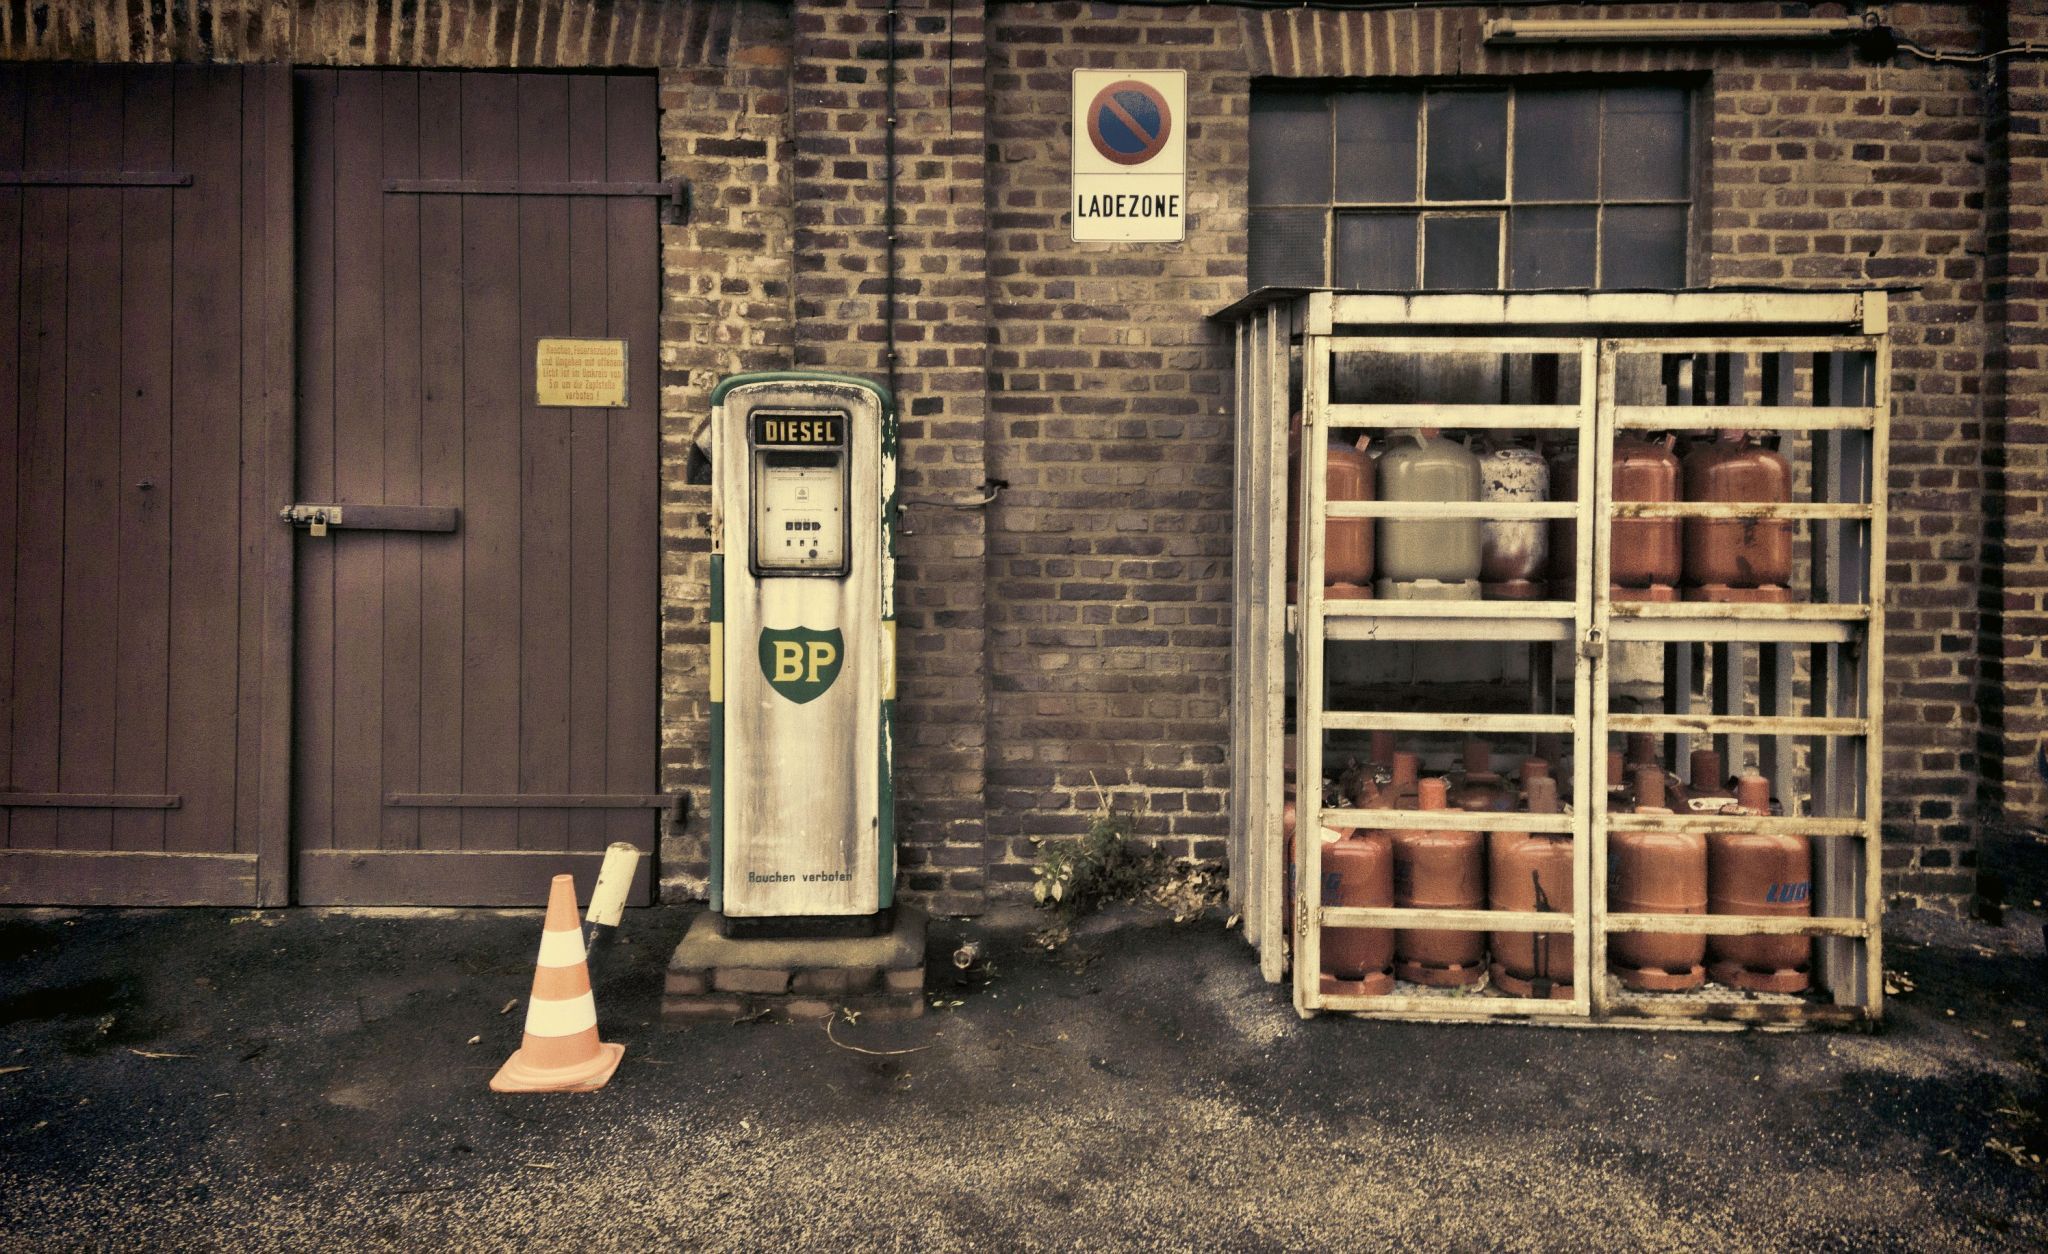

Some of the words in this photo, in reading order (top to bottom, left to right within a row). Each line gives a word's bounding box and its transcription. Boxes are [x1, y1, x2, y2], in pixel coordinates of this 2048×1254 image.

[1078, 194, 1179, 218] LADEZONE
[766, 421, 835, 441] DIESEL
[772, 641, 836, 682] BP
[748, 871, 796, 883] Rauchen
[802, 871, 853, 882] verboten
